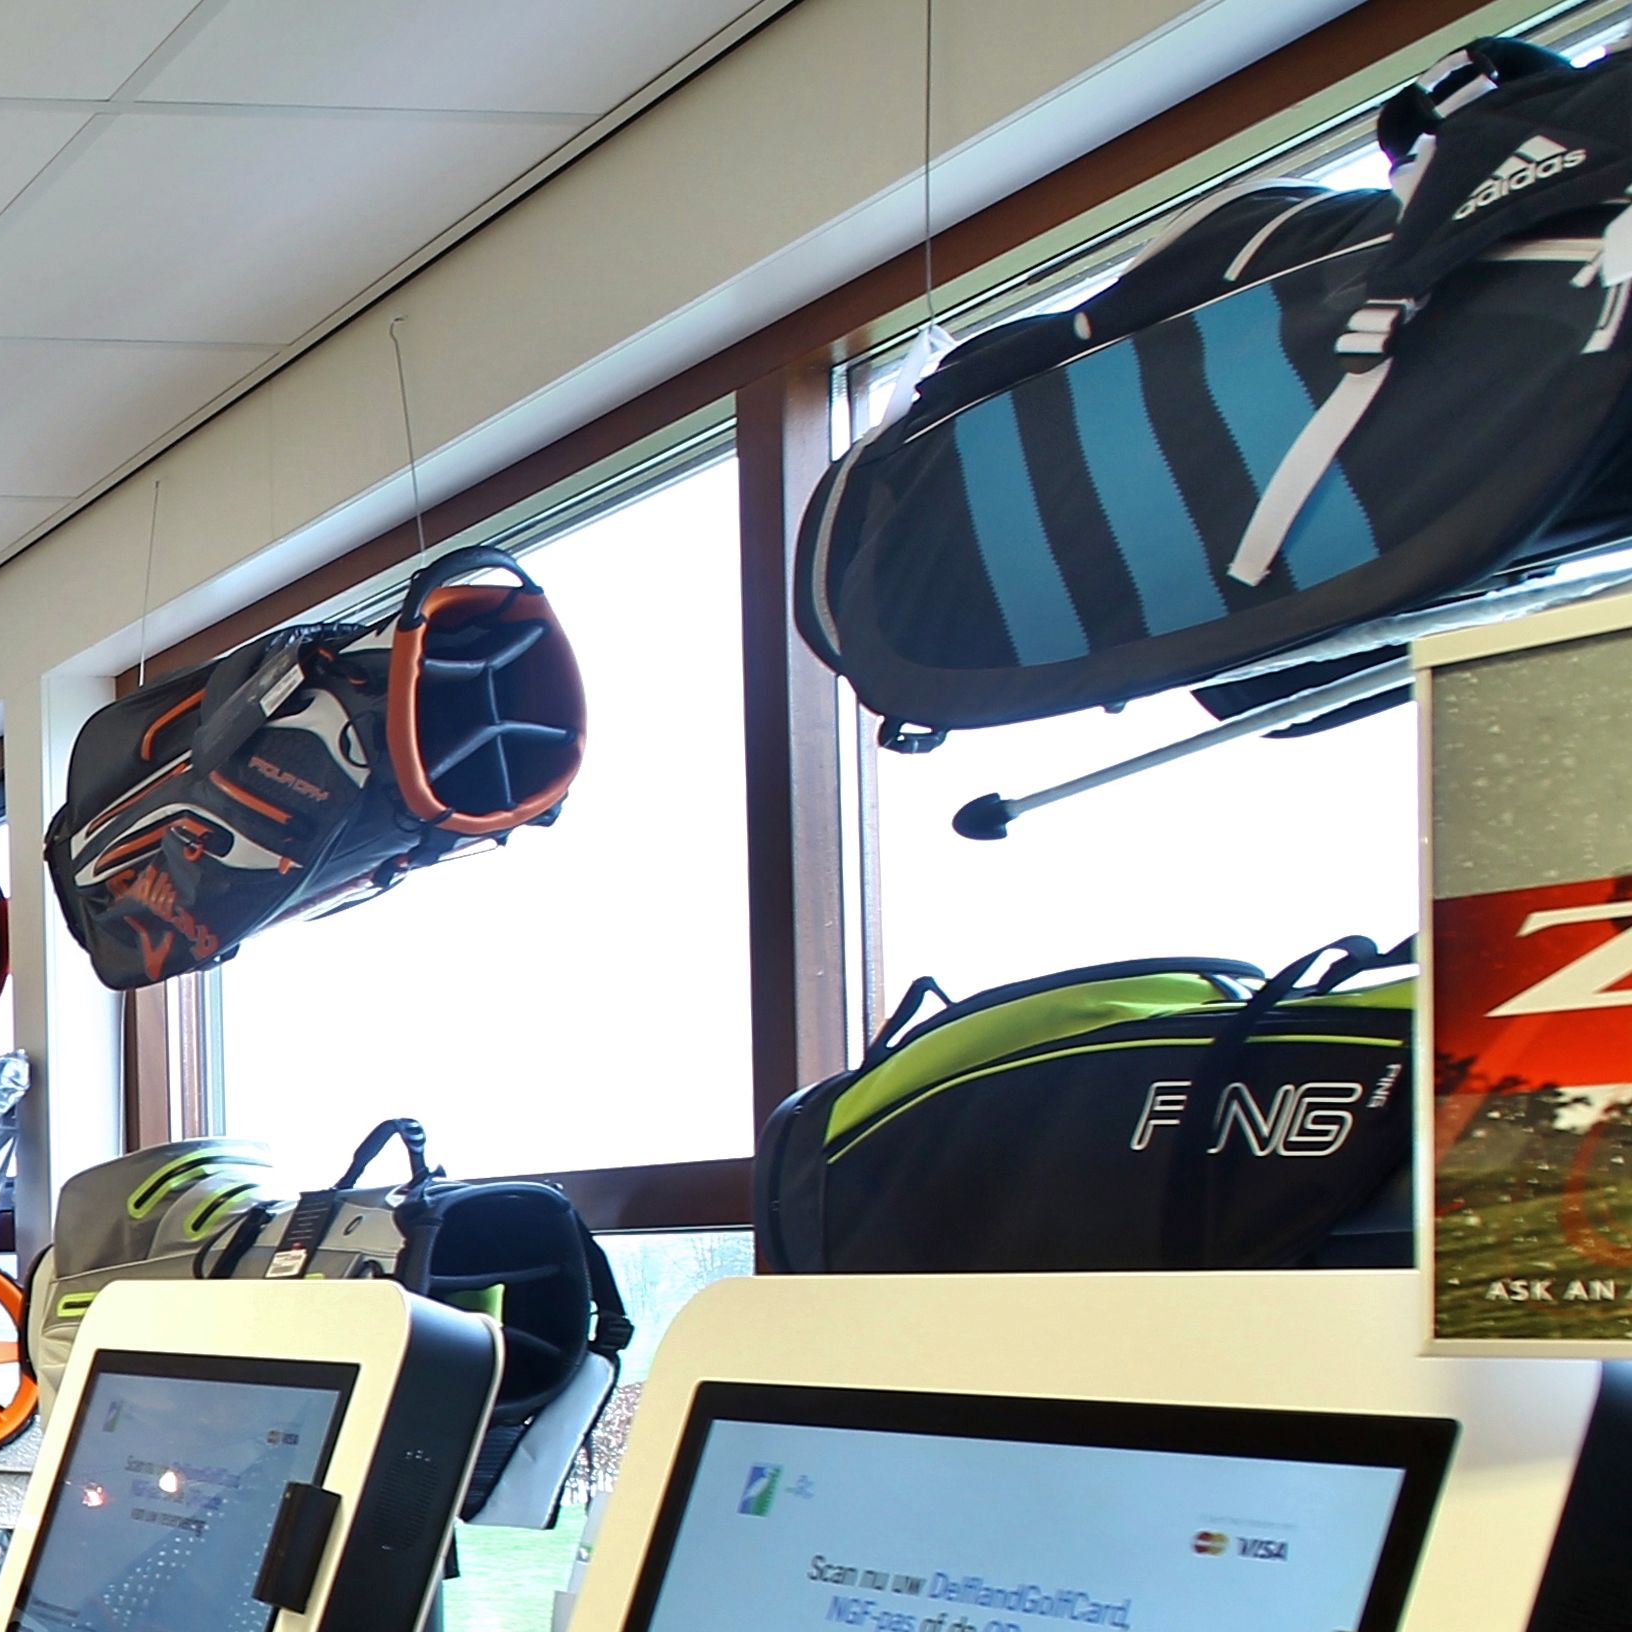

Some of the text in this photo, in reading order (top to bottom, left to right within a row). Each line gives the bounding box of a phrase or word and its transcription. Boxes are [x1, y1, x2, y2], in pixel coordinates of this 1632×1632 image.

[1451, 149, 1587, 222] adidas
[1130, 1081, 1363, 1157] PNG
[1485, 1279, 1554, 1302] ASK
[1562, 1278, 1616, 1302] AN
[1236, 1536, 1288, 1561] VISA
[807, 1554, 1133, 1632] Scan nu uw DelflandGolfCard,
